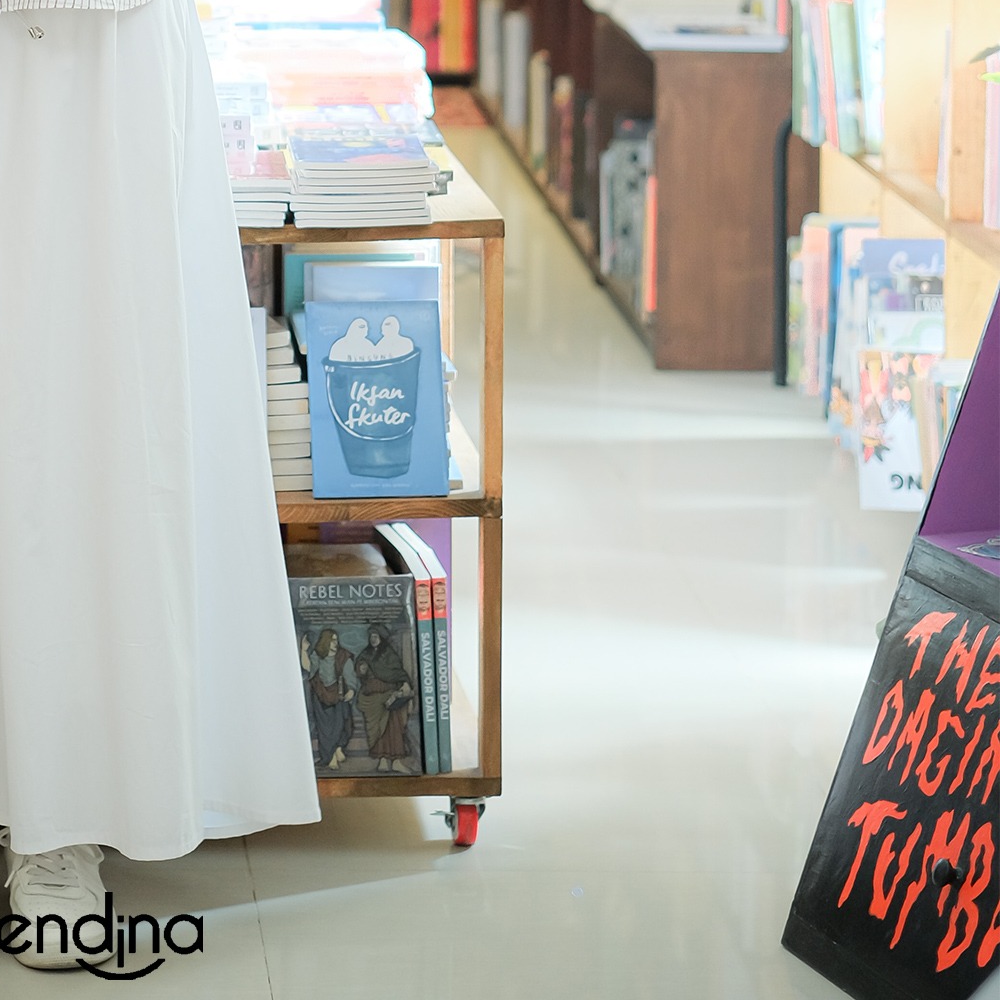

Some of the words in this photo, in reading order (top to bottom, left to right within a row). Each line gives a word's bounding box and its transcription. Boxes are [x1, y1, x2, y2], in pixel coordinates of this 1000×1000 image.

[299, 584, 345, 600] REBEL
[349, 583, 403, 599] NOTES
[421, 631, 434, 694] SALVADOR
[437, 630, 448, 692] SALVADOR
[838, 799, 1000, 973] TUMB
